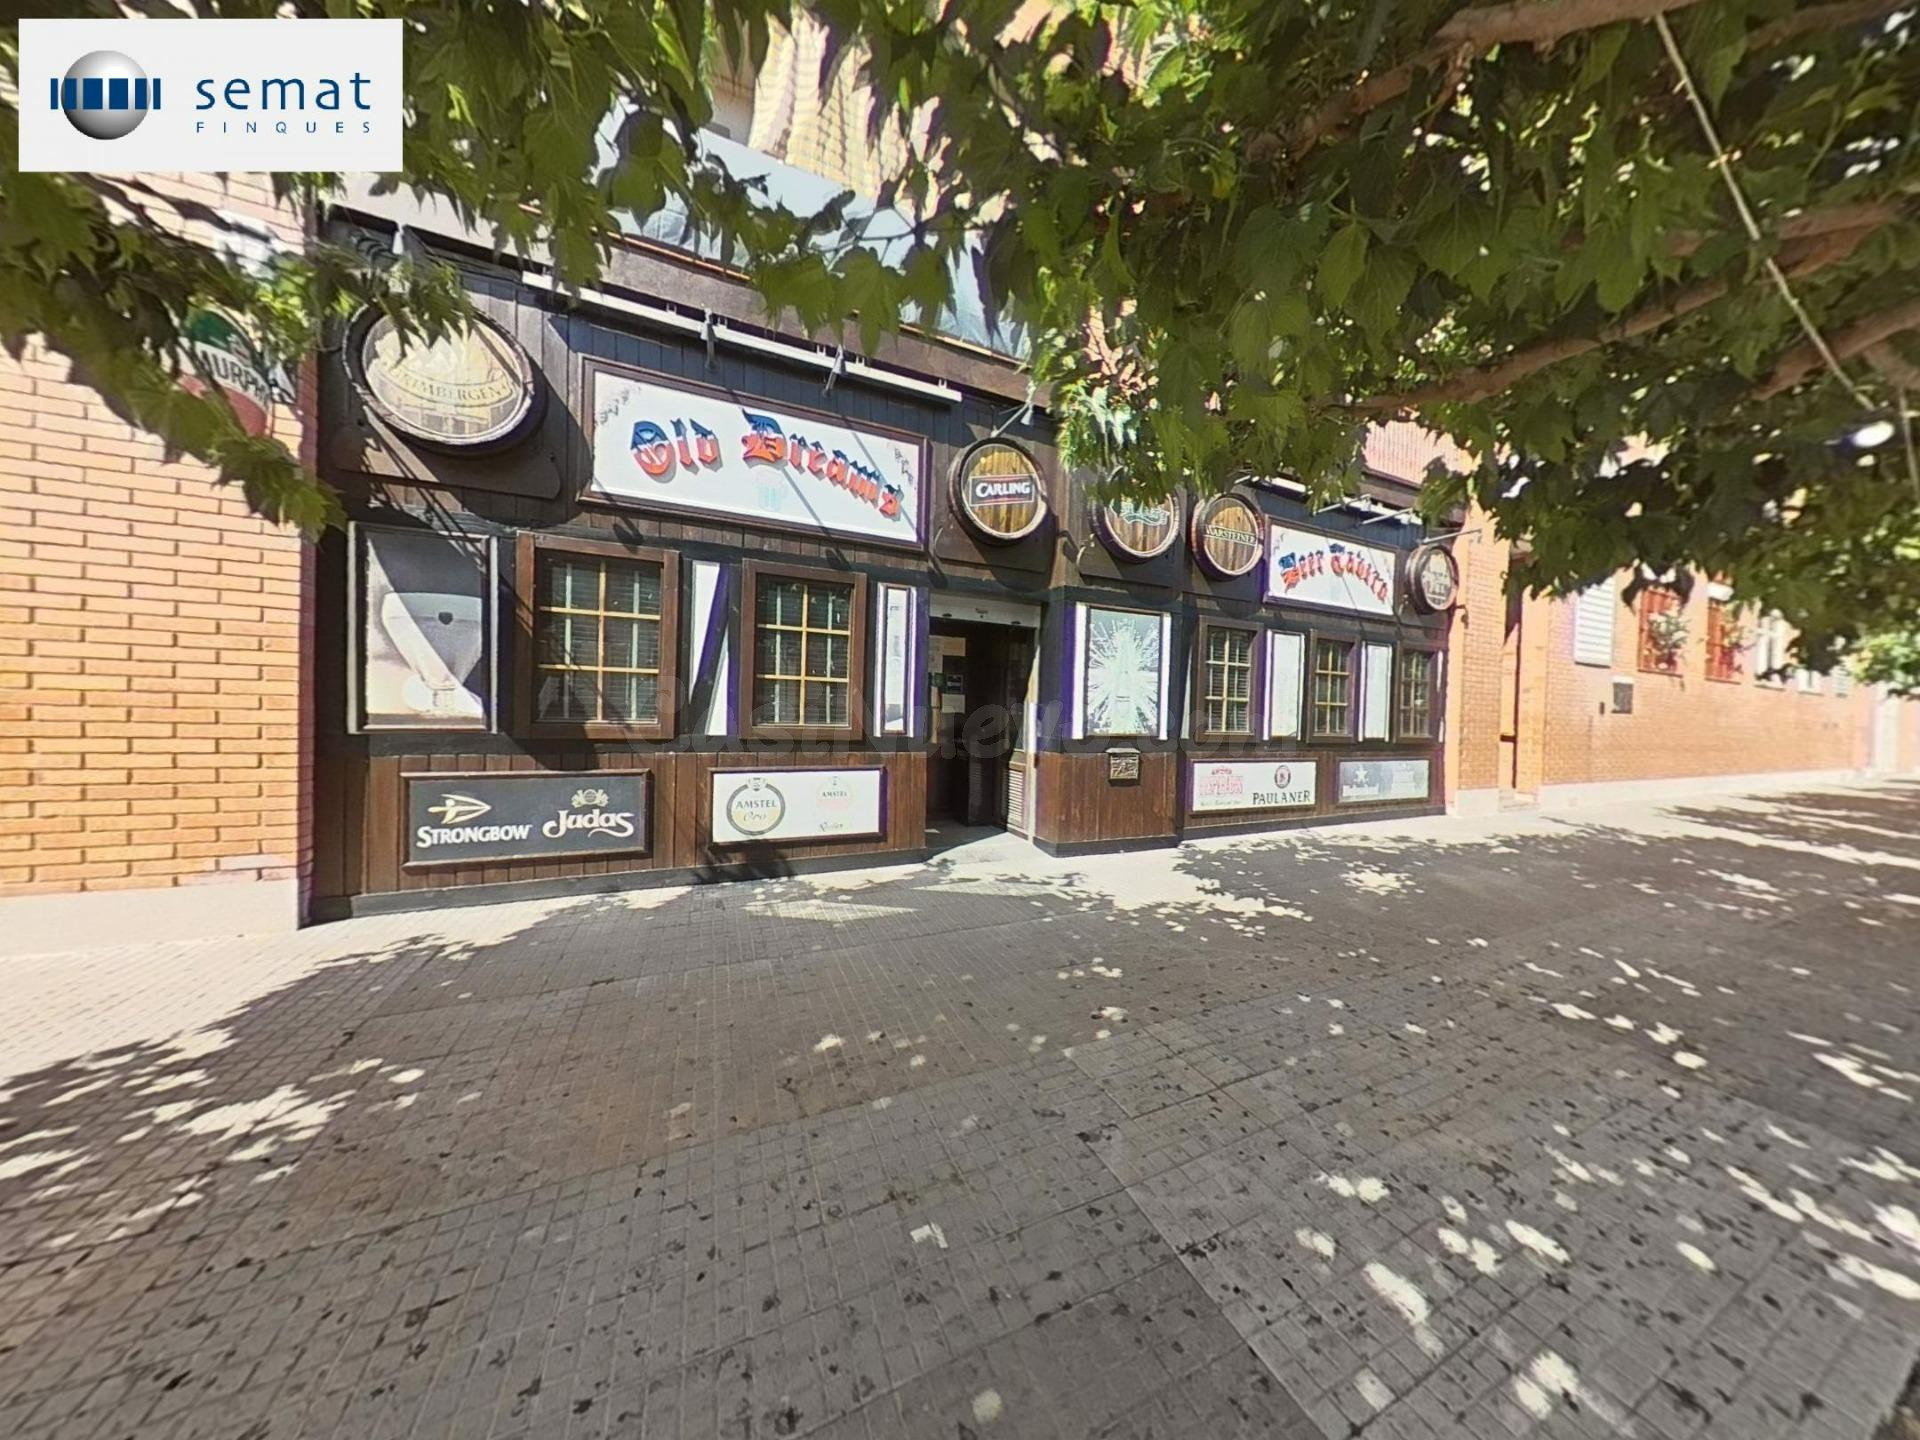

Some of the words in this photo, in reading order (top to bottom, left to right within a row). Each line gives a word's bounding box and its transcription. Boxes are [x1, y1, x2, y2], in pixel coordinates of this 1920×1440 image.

[630, 417, 722, 476] Old
[741, 408, 904, 519] Dreams
[975, 481, 1031, 498] CARLING
[736, 799, 777, 810] AMSTEL
[1252, 790, 1312, 805] PAULANER
[542, 809, 635, 838] Judas
[416, 825, 531, 848] STRONGBOW
